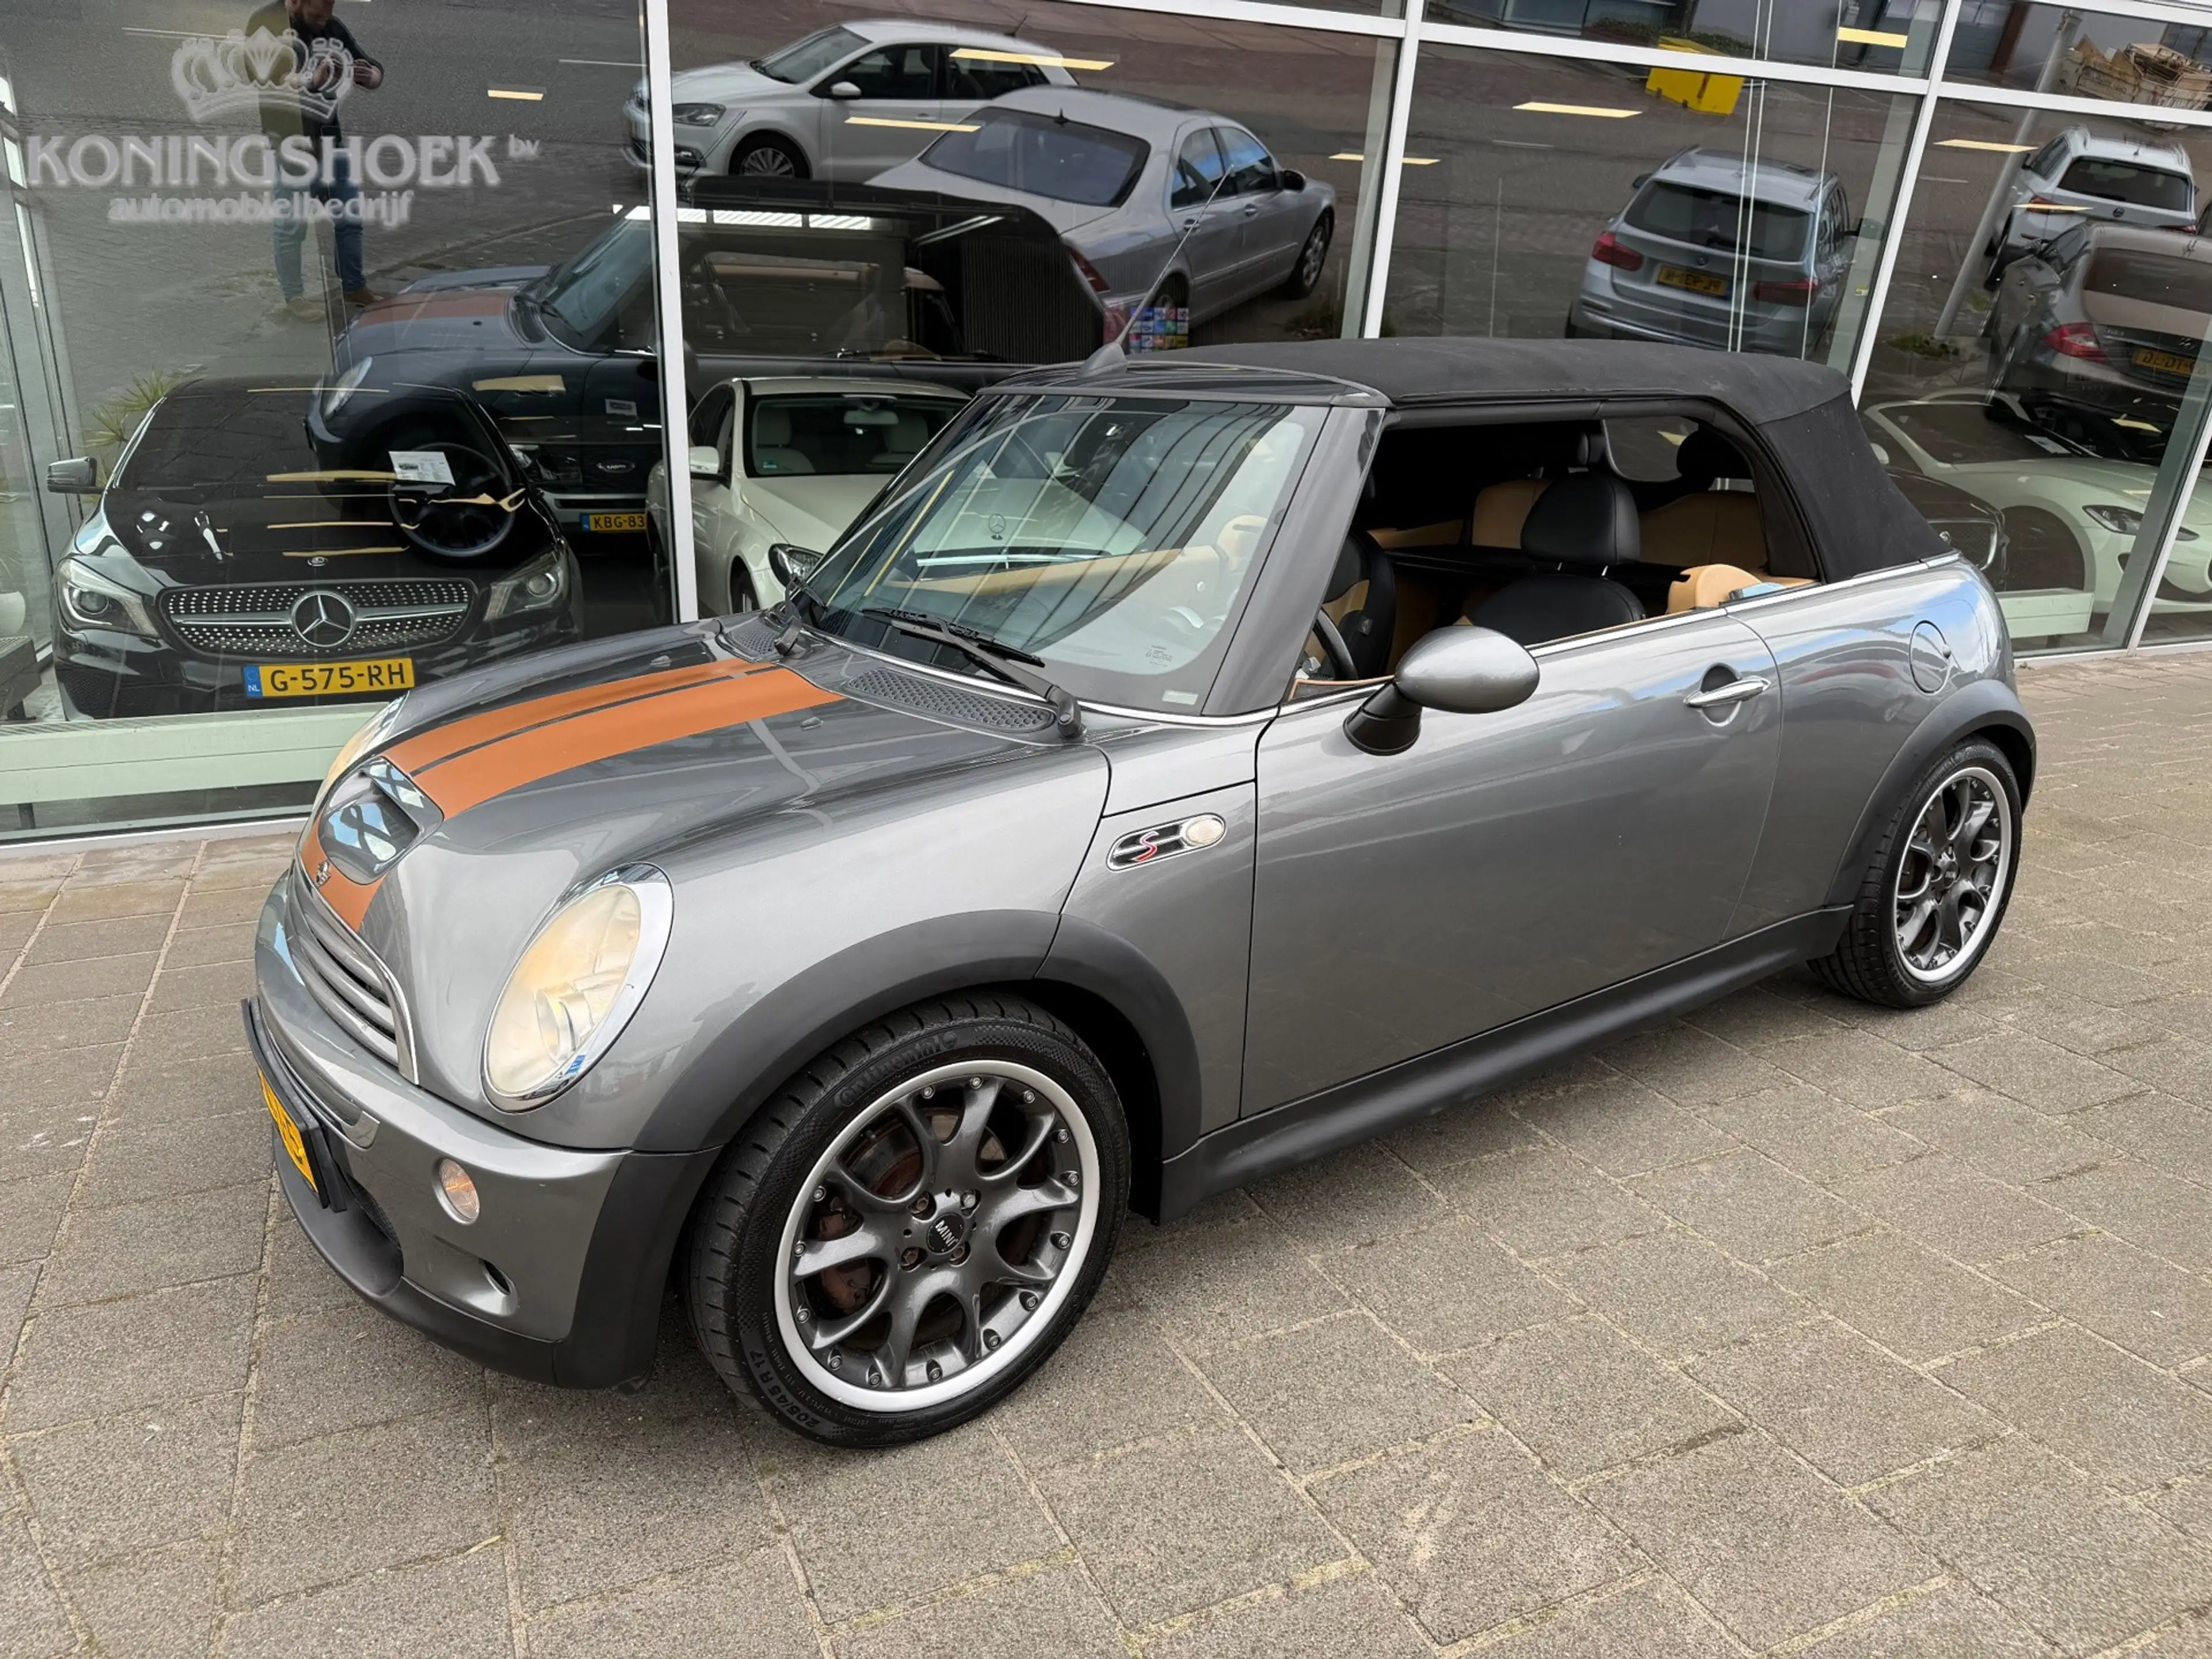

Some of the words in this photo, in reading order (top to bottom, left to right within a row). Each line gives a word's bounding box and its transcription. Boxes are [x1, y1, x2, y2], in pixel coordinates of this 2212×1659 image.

[593, 516, 645, 529] KBG-83
[270, 662, 406, 692] G-575-RH
[1131, 830, 1160, 862] S
[834, 1035, 943, 1107] Continental
[935, 1219, 957, 1247] MINI
[749, 1350, 766, 1368] 17
[760, 1370, 773, 1384] R
[767, 1384, 820, 1428] 205/45
